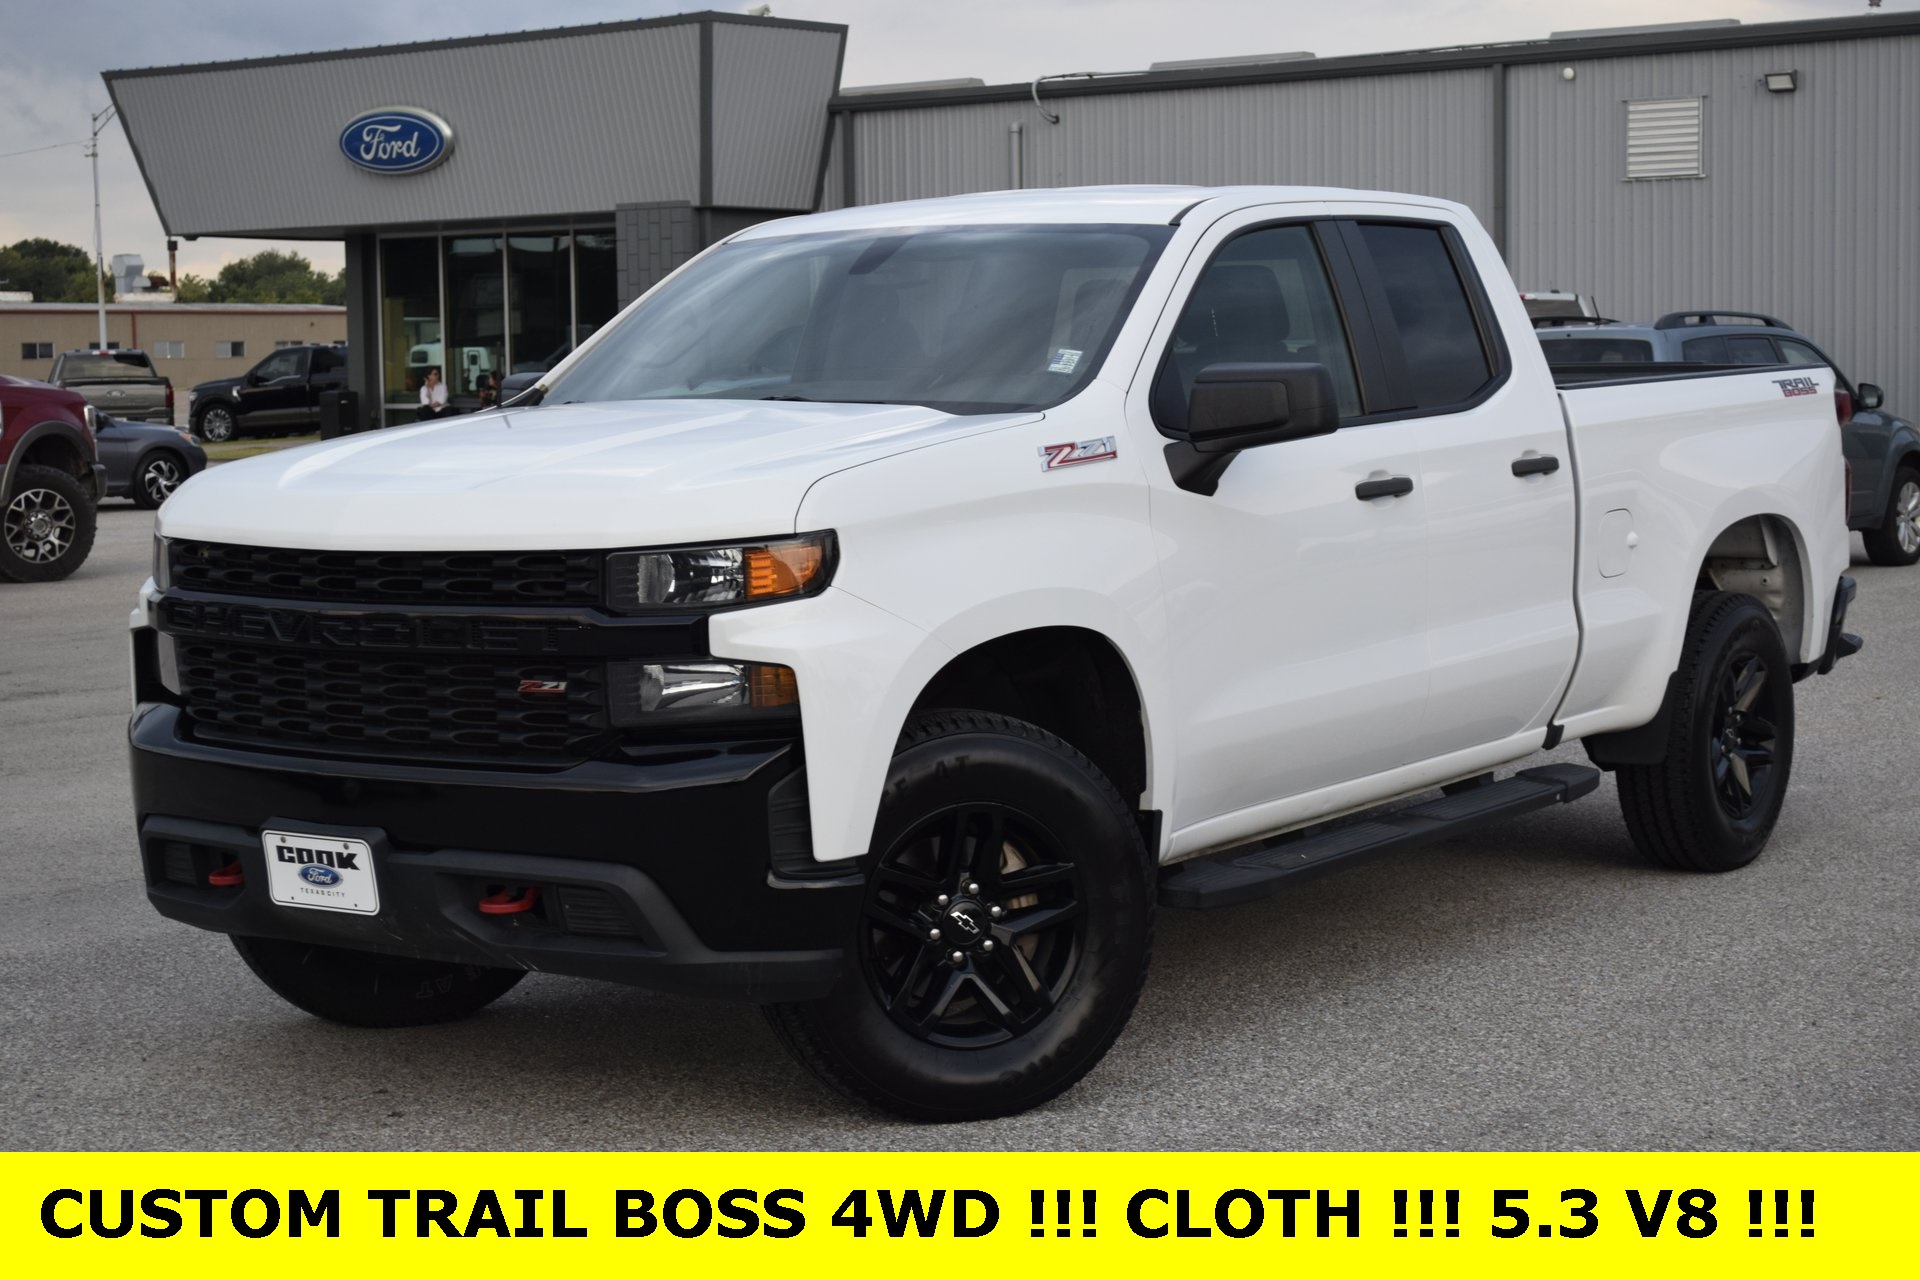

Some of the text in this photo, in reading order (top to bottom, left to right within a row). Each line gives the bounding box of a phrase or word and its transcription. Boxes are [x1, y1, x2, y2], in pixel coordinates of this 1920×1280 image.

[360, 124, 421, 161] Ford
[1771, 377, 1820, 389] TRAIL
[1783, 386, 1818, 398] BOSS
[1038, 435, 1117, 472] Z71
[166, 603, 579, 651] CHEVROLET
[517, 679, 568, 693] Z71
[275, 845, 361, 871] COOK
[307, 867, 332, 884] Ford
